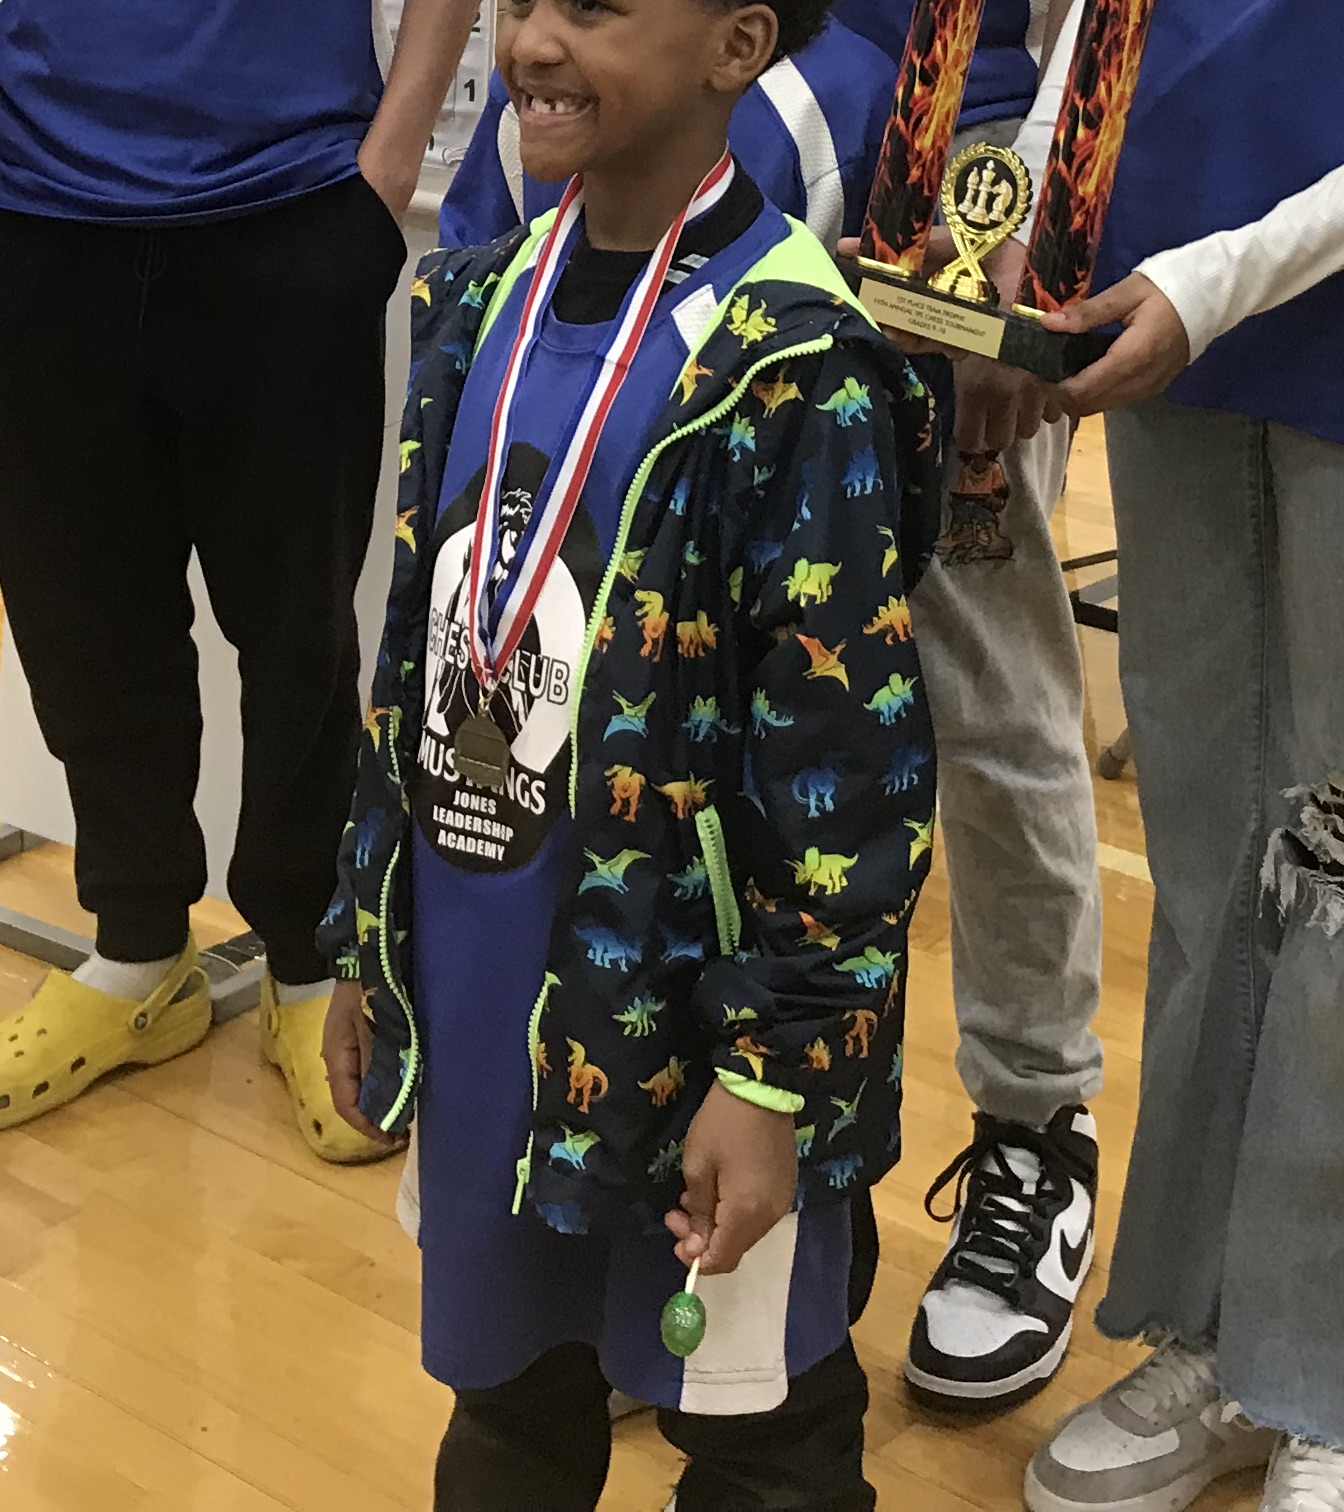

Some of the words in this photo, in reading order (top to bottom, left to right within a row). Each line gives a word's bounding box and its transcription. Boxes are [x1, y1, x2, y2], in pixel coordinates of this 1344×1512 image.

[463, 79, 475, 102] 1
[429, 607, 470, 670] CHES
[417, 730, 547, 816] MUSNGS
[453, 790, 496, 815] JONES
[433, 805, 515, 844] LEADERSHIP
[437, 829, 506, 862] ACADEMY
